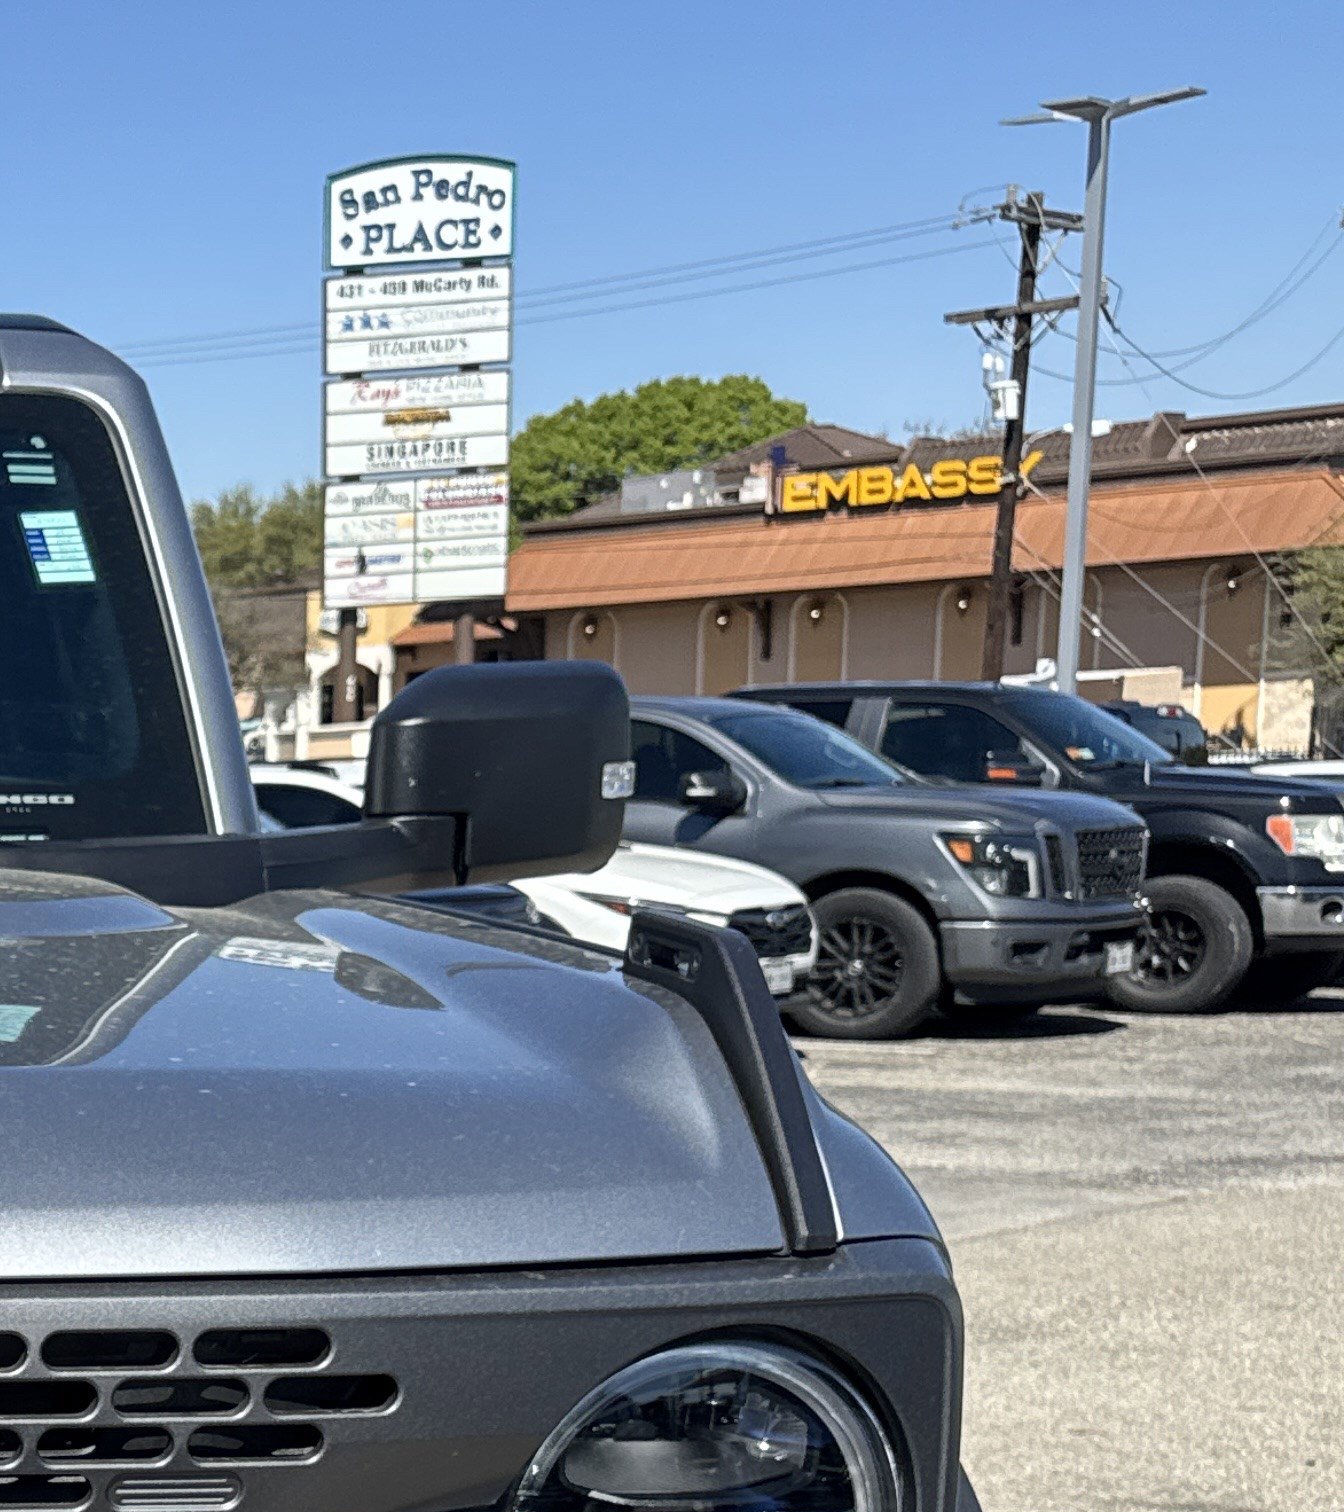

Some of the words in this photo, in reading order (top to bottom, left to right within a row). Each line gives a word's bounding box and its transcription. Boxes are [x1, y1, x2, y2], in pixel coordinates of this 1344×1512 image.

[339, 184, 402, 220] San
[410, 169, 507, 211] Pedro
[359, 217, 482, 256] PLACE
[412, 276, 473, 294] McCarty
[365, 440, 469, 462] SINGAPORE
